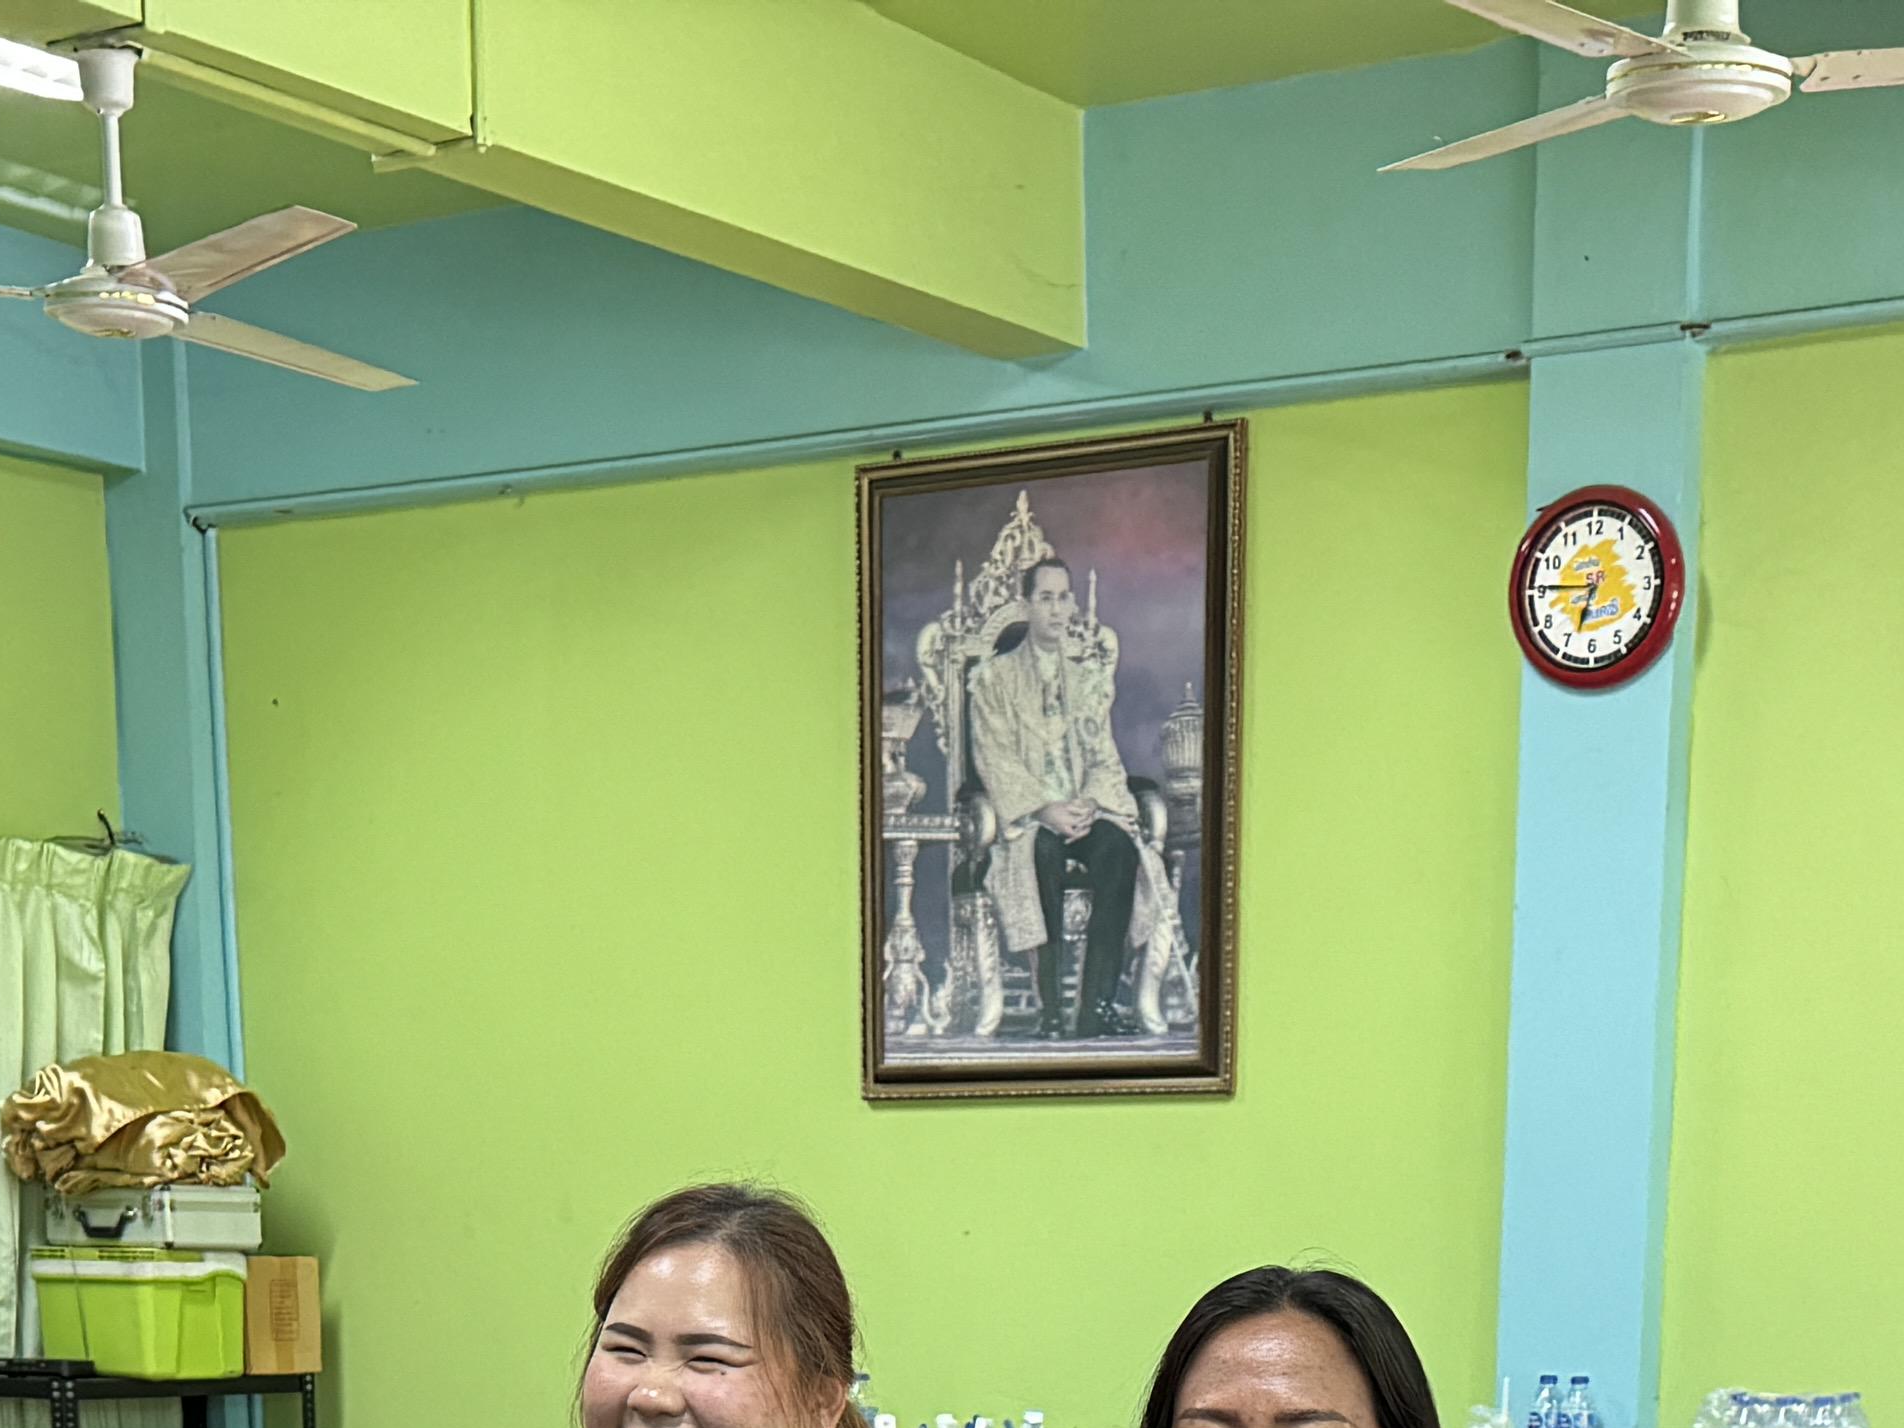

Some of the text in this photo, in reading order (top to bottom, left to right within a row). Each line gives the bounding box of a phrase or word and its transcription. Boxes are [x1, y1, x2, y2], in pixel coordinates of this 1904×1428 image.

[1587, 519, 1604, 536] 12
[1618, 526, 1625, 541] 1
[1562, 531, 1578, 547] 11
[1635, 545, 1645, 560] 2
[1544, 555, 1561, 571] 10
[1643, 576, 1652, 591] 3
[1537, 585, 1546, 599] 9
[1544, 614, 1553, 629] 8
[1633, 607, 1642, 622] 4
[1563, 633, 1573, 648] 7
[1613, 629, 1623, 645] 5
[1587, 638, 1597, 654] 6
